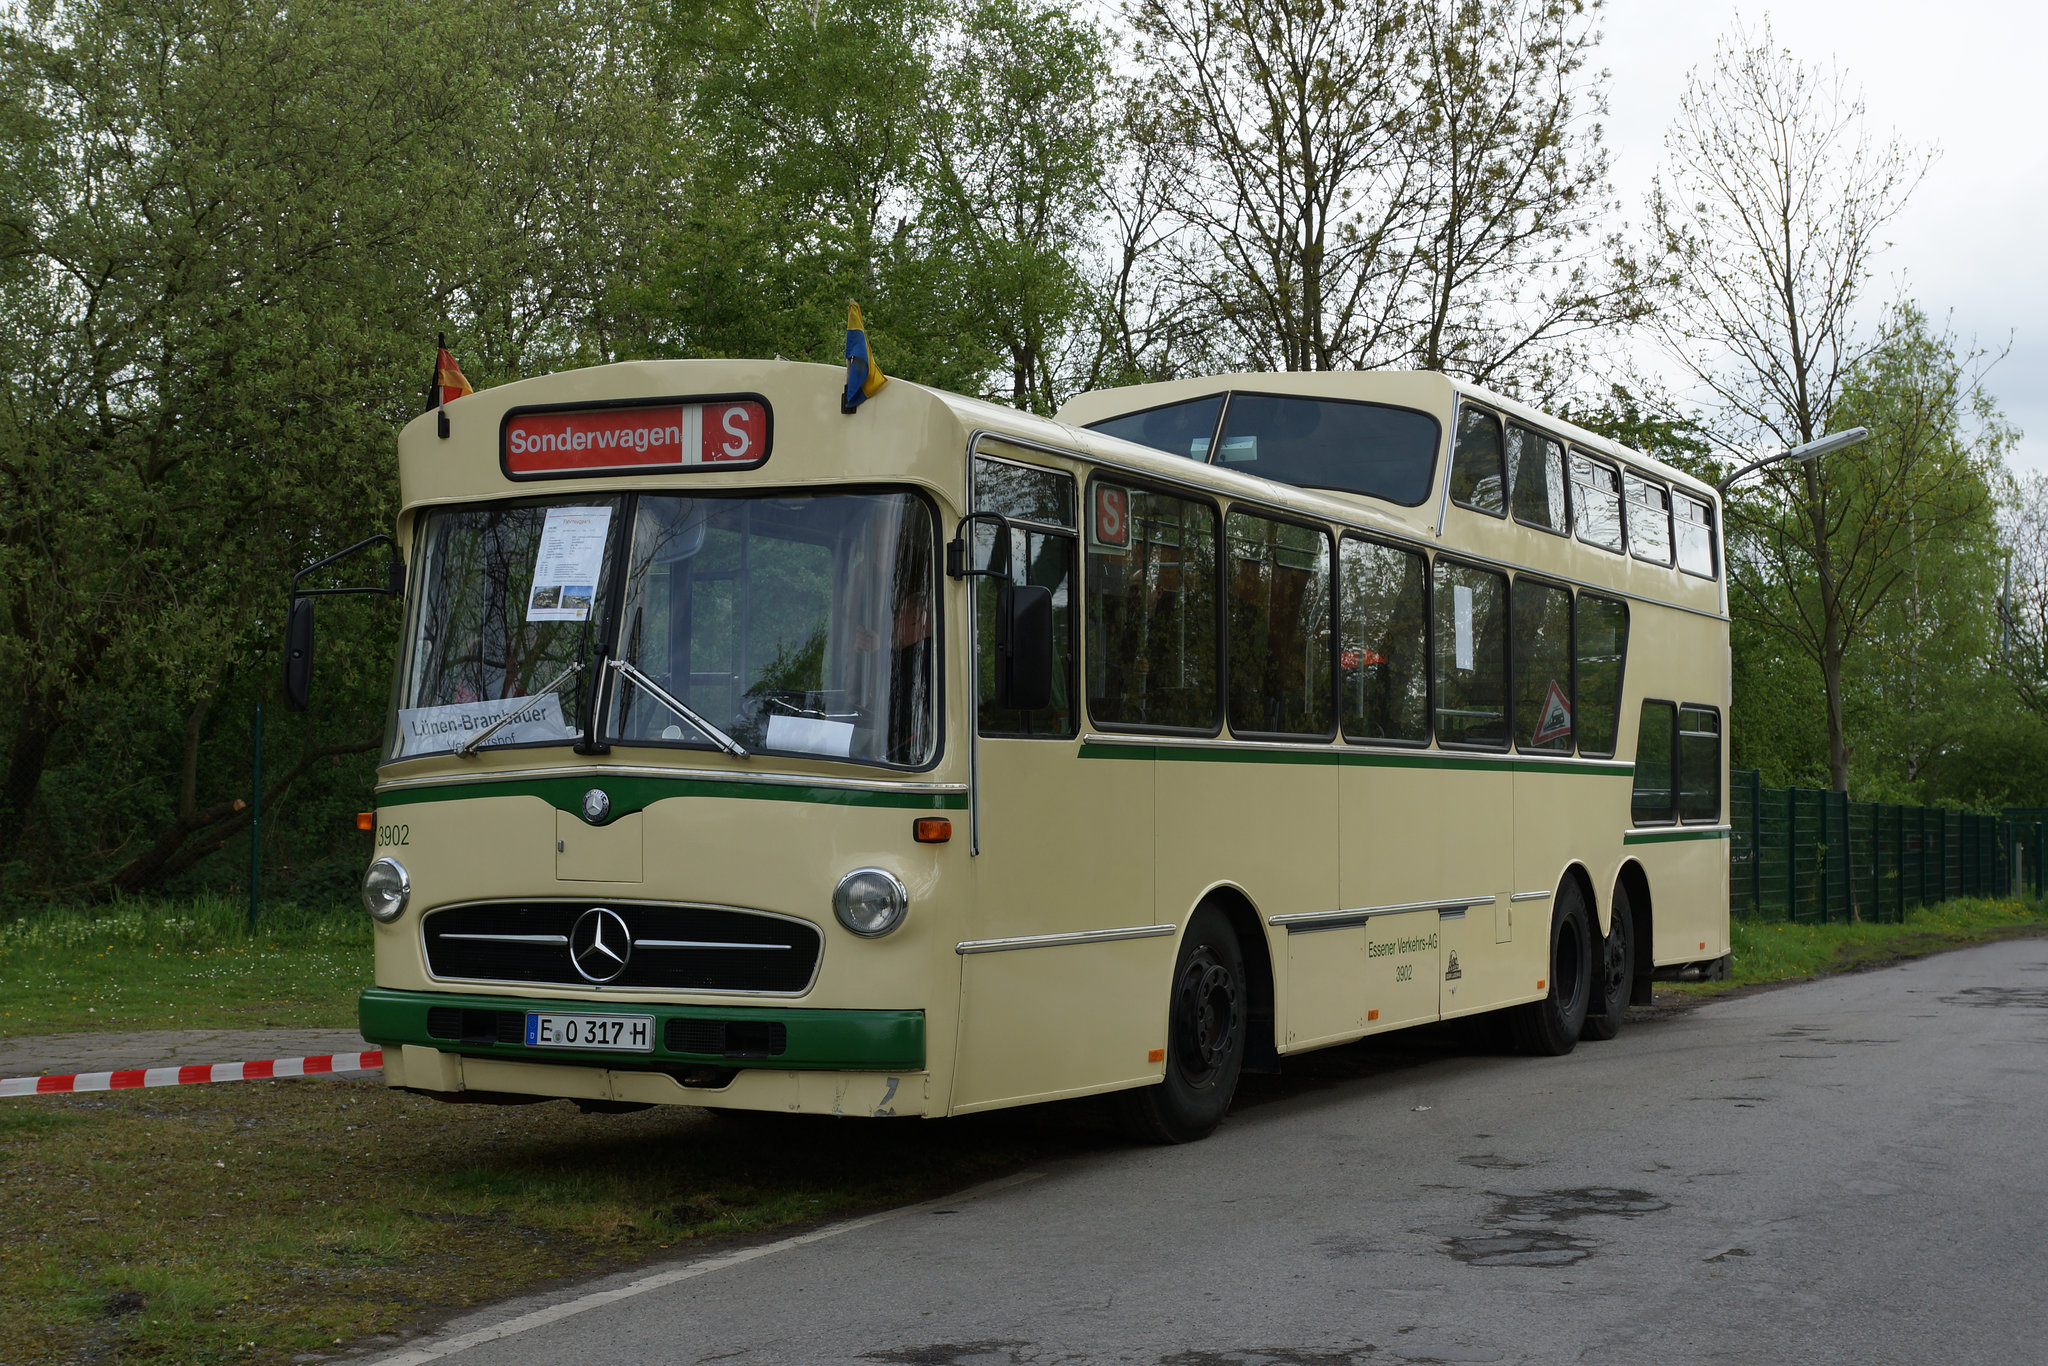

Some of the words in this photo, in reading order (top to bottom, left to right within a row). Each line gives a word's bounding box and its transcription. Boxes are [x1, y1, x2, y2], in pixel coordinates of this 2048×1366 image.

[510, 425, 680, 454] Sonderwagen
[722, 407, 749, 457] S
[1103, 490, 1119, 535] S
[378, 824, 410, 847] 3902
[1368, 941, 1396, 958] Essener
[1397, 933, 1437, 954] Verkehrs-AG
[1396, 964, 1413, 982] 3902
[540, 1019, 552, 1042] E
[584, 1020, 624, 1045] 317
[632, 1022, 647, 1045] H
